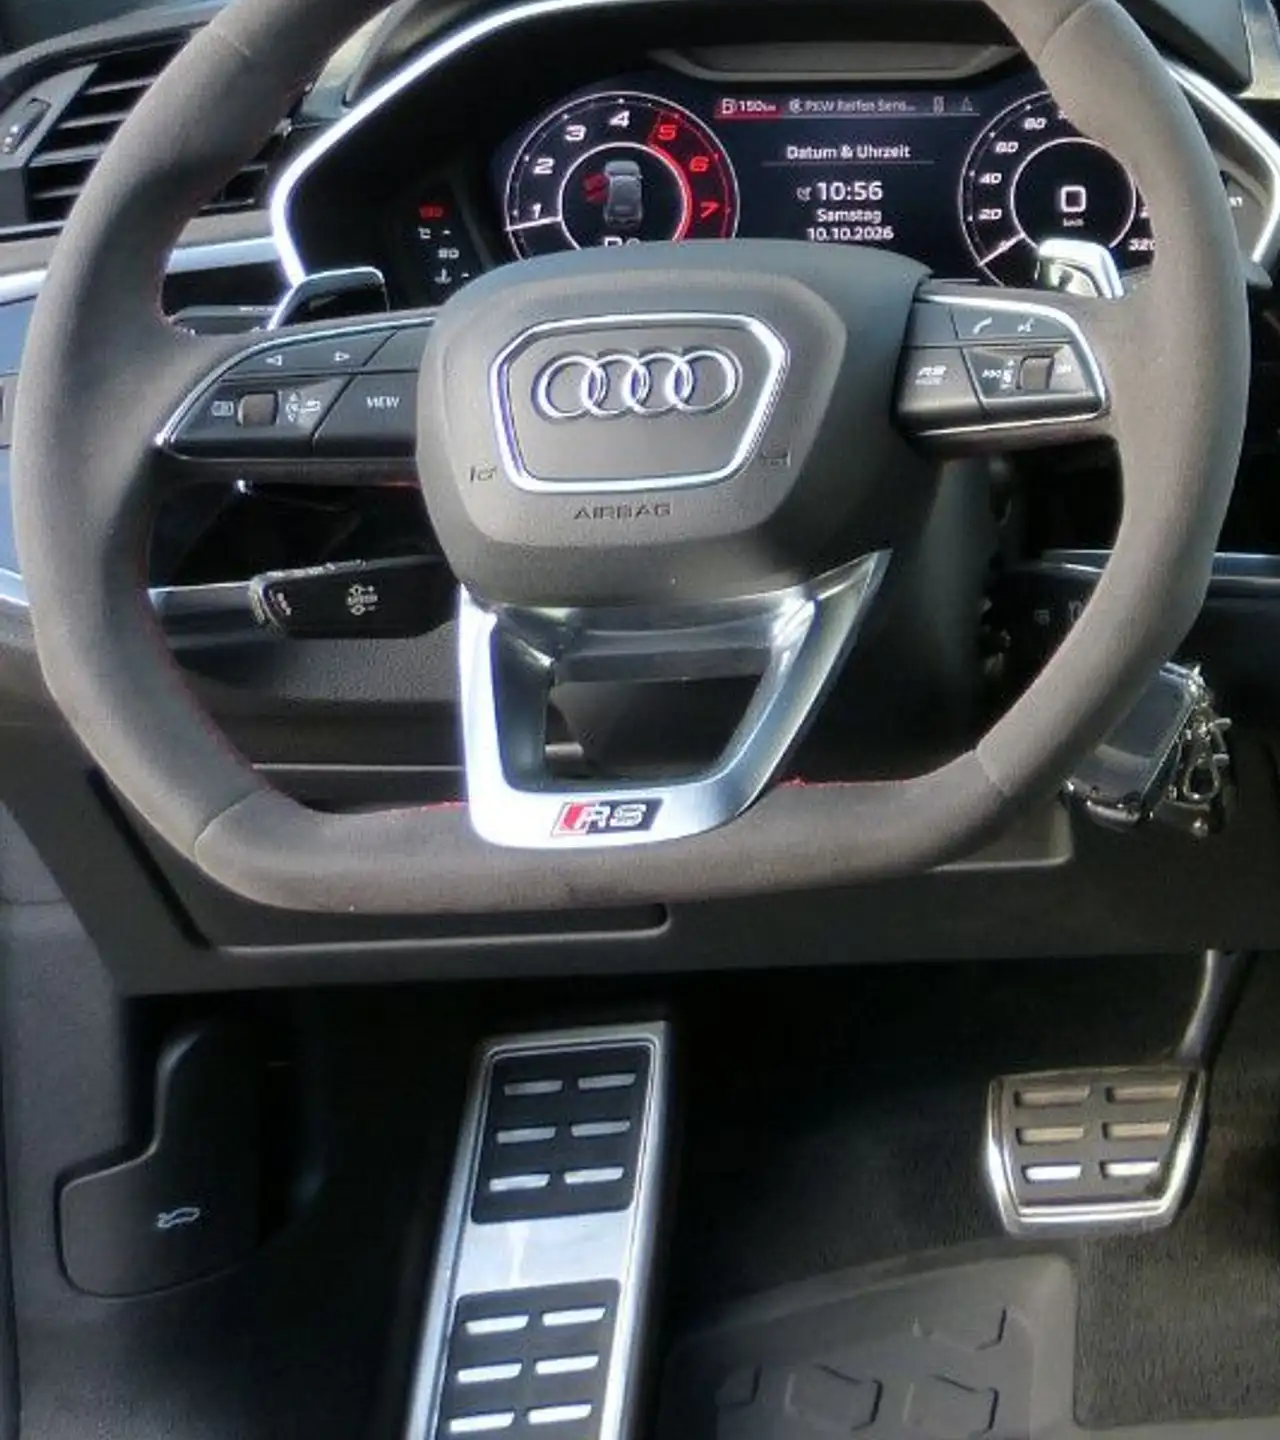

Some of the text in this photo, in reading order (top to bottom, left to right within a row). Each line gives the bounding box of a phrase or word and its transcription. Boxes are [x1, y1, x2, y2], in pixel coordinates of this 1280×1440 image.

[608, 110, 631, 128] 4
[563, 124, 588, 141] 3
[657, 124, 677, 141] 5
[786, 143, 911, 159] Datum & Uhrzeit
[532, 157, 556, 175] 2
[689, 155, 711, 173] 6
[979, 172, 1003, 185] 40
[815, 181, 884, 201] 10:56
[1060, 184, 1087, 213] 0
[531, 201, 543, 219] 1
[699, 200, 720, 219] 7
[816, 208, 883, 225] Samstag
[977, 208, 1003, 221] 20
[805, 225, 895, 242] 10.10.2026
[366, 395, 401, 410] VIEW
[573, 503, 672, 521] AIRBAG
[575, 803, 648, 831] RS
